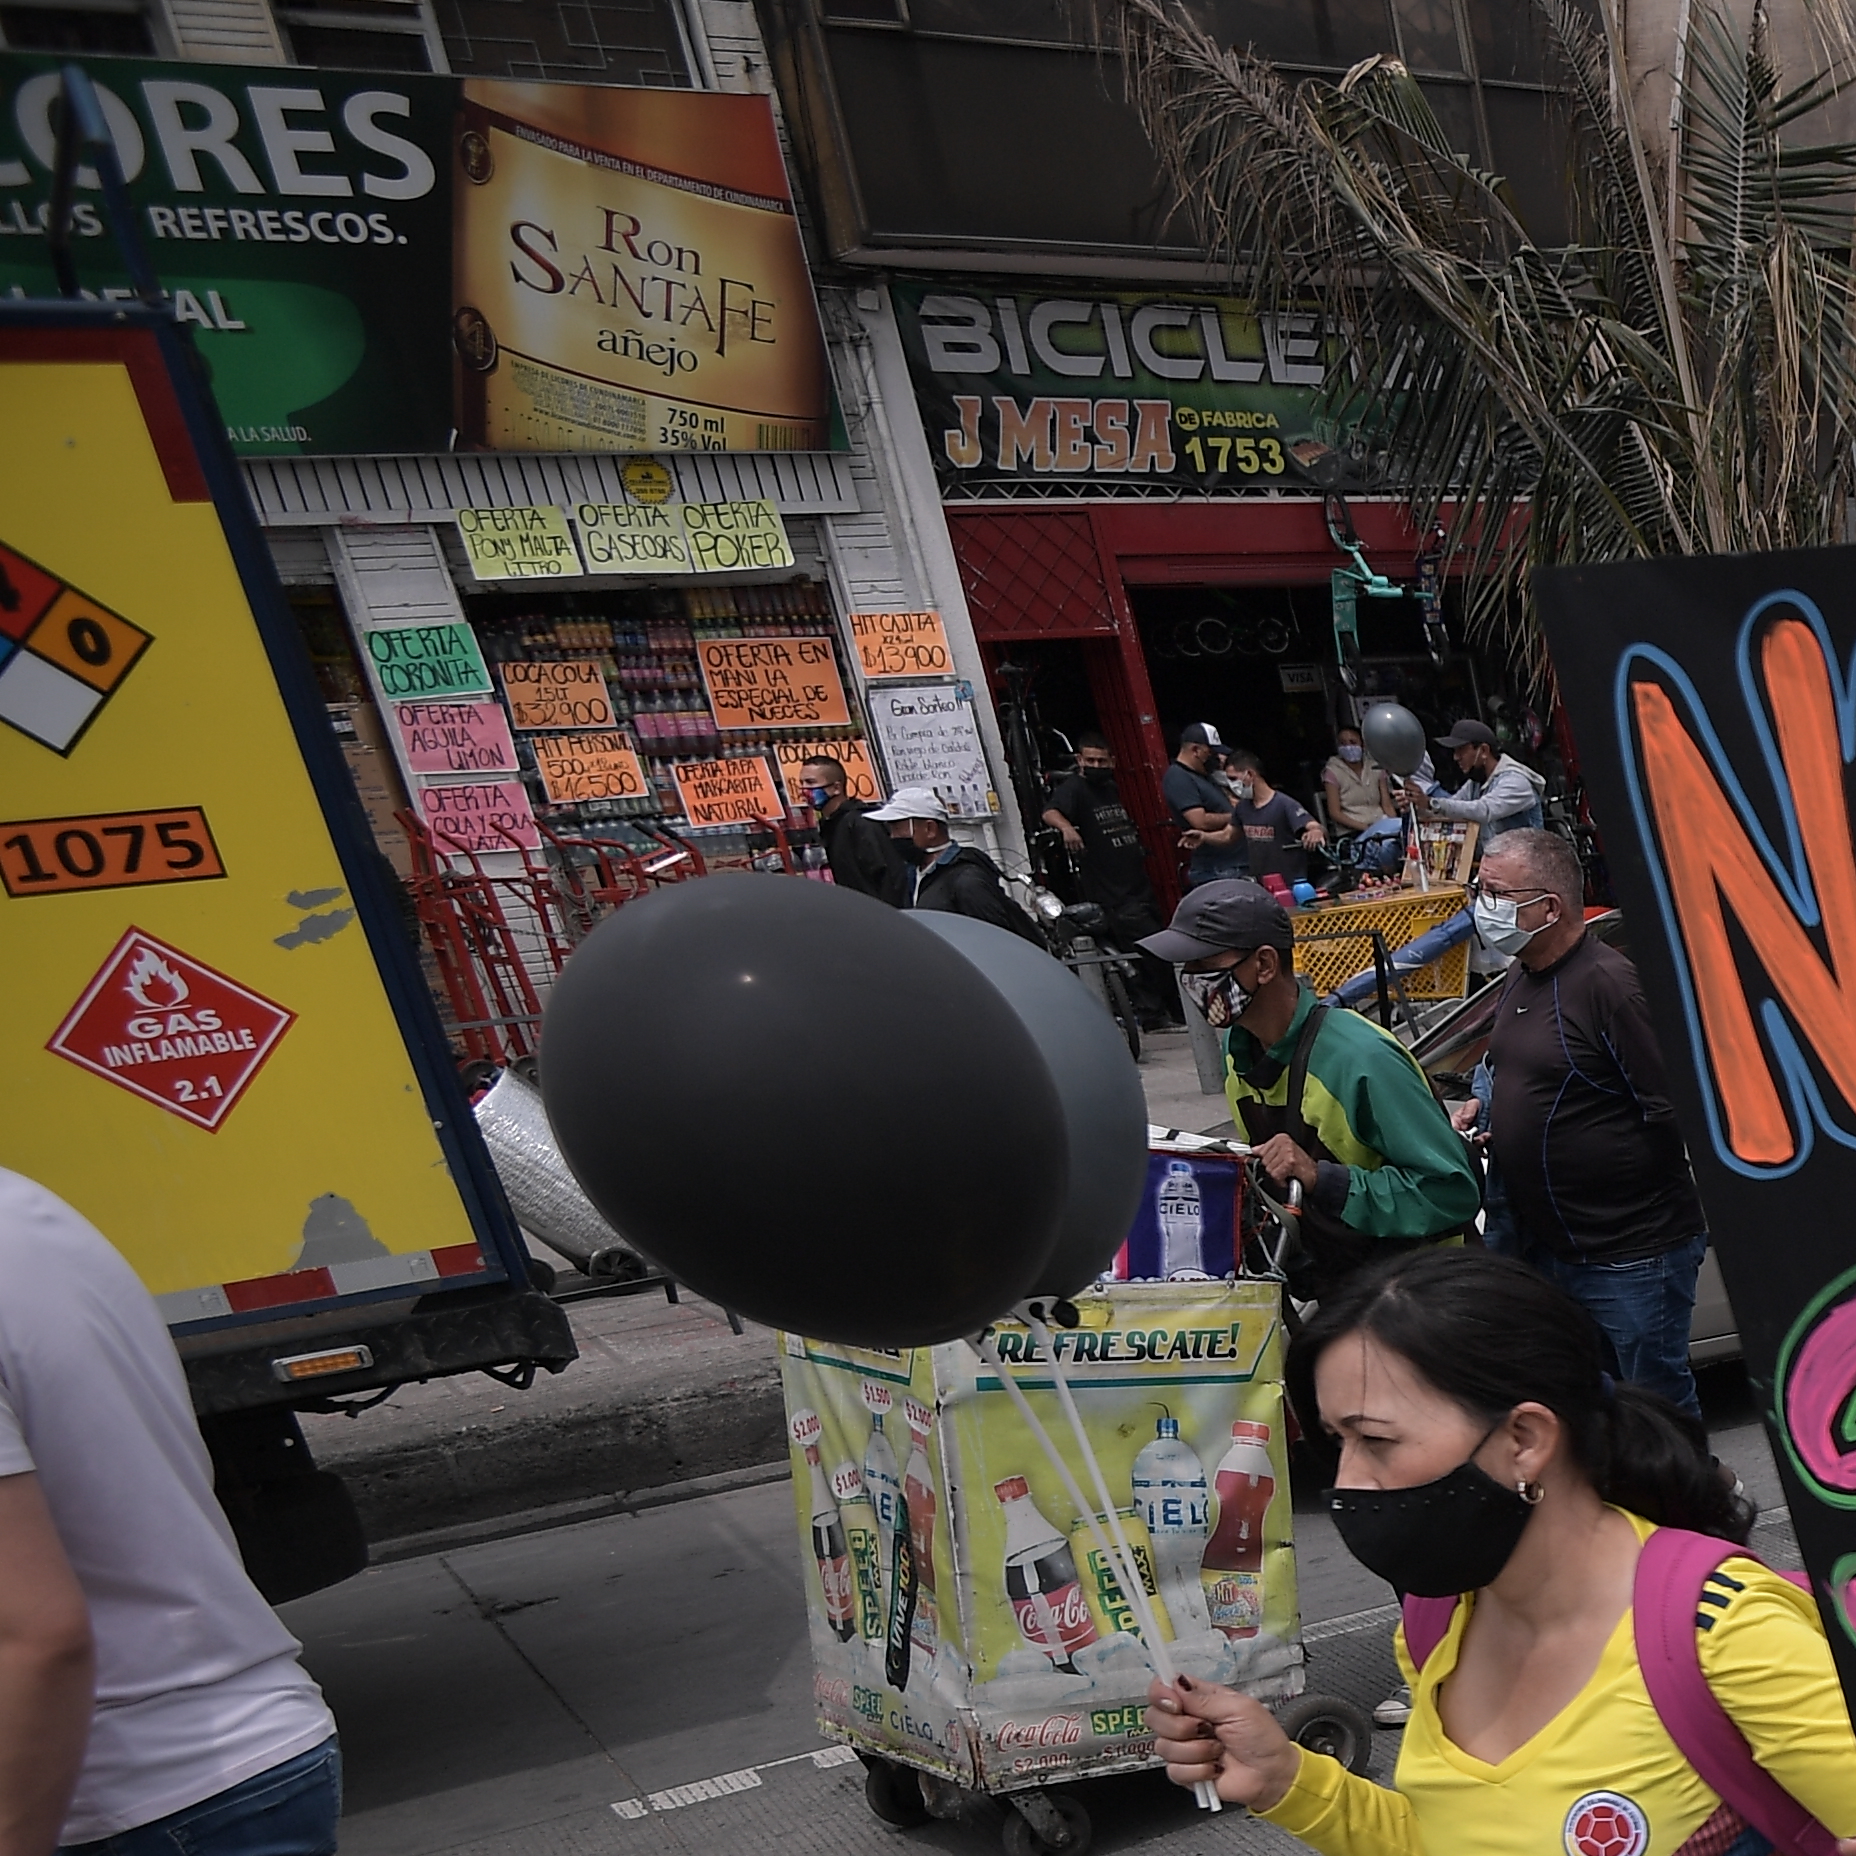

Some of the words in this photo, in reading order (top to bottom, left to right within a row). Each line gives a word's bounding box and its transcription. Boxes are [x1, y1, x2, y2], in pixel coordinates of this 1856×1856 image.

[0, 72, 436, 200] ORES
[516, 125, 558, 151] ENVASADO
[558, 141, 581, 159] PARA
[581, 149, 593, 163] LA
[593, 152, 621, 171] VENTA
[622, 162, 635, 176] EN
[635, 166, 646, 179] EL
[647, 169, 712, 198] DEPARTAMENTO
[713, 186, 725, 200] DE
[725, 189, 784, 213] CUNDINAMARCA
[147, 206, 408, 245] REFRESCOS.
[596, 205, 703, 277] Ron
[597, 326, 699, 377] añejo
[918, 294, 1440, 390] BICICLE
[668, 408, 698, 428] 750
[704, 417, 724, 434] ml
[1178, 413, 1199, 425] DE
[1202, 410, 1280, 429] FABRICA
[240, 426, 260, 442] LA
[261, 426, 312, 442] SALUD.
[660, 427, 697, 450] 35%
[945, 396, 982, 468] J
[995, 396, 1176, 473] MESA
[1184, 437, 1285, 475] 1753
[459, 507, 546, 532] OFERTA
[579, 504, 670, 528] OFERTA
[683, 502, 777, 530] OFERTA
[470, 534, 516, 561] PONY
[520, 533, 572, 557] MALTA
[587, 531, 685, 563] GASEOSAS
[693, 531, 786, 571] POKER
[504, 561, 562, 577] LITRO
[851, 615, 877, 636] HIT
[879, 613, 936, 633] CAJITA
[68, 617, 111, 667] 0
[369, 625, 469, 662] OFERTA
[707, 644, 794, 668] OFERTA
[799, 642, 830, 664] EN
[380, 659, 483, 695] CORONITA
[504, 663, 551, 686] COCA
[552, 664, 600, 685] COLA
[711, 669, 757, 687] MANI
[768, 670, 790, 687] LA
[1288, 672, 1314, 683] VISA
[715, 688, 799, 709] ESPECIAL
[804, 685, 828, 701] DE
[400, 704, 485, 726] OFERTA
[750, 703, 821, 722] NUECES
[412, 727, 476, 752] AGUILA
[533, 738, 562, 758] HIT
[568, 732, 633, 753] PERSONAL
[778, 743, 815, 764] COCA
[816, 741, 864, 763] COLA
[449, 747, 505, 771] LIMON
[676, 760, 722, 784] OFERTA
[726, 757, 758, 777] PAPA
[424, 785, 511, 812] OFERTA
[694, 776, 764, 799] MARGARITA
[694, 798, 767, 823] NATURAL
[434, 816, 478, 834] COLA
[5, 821, 204, 883] 1075
[468, 835, 508, 851] LATA
[128, 1009, 222, 1039] GAS
[104, 1028, 257, 1067] INFLAMABLE
[175, 1075, 223, 1102] 2.1
[1159, 1202, 1200, 1216] CIELO
[794, 1415, 820, 1440] $2.000
[890, 1710, 933, 1741] CIELO
[1090, 1704, 1151, 1736] SPEE
[1127, 1728, 1152, 1738] MA
